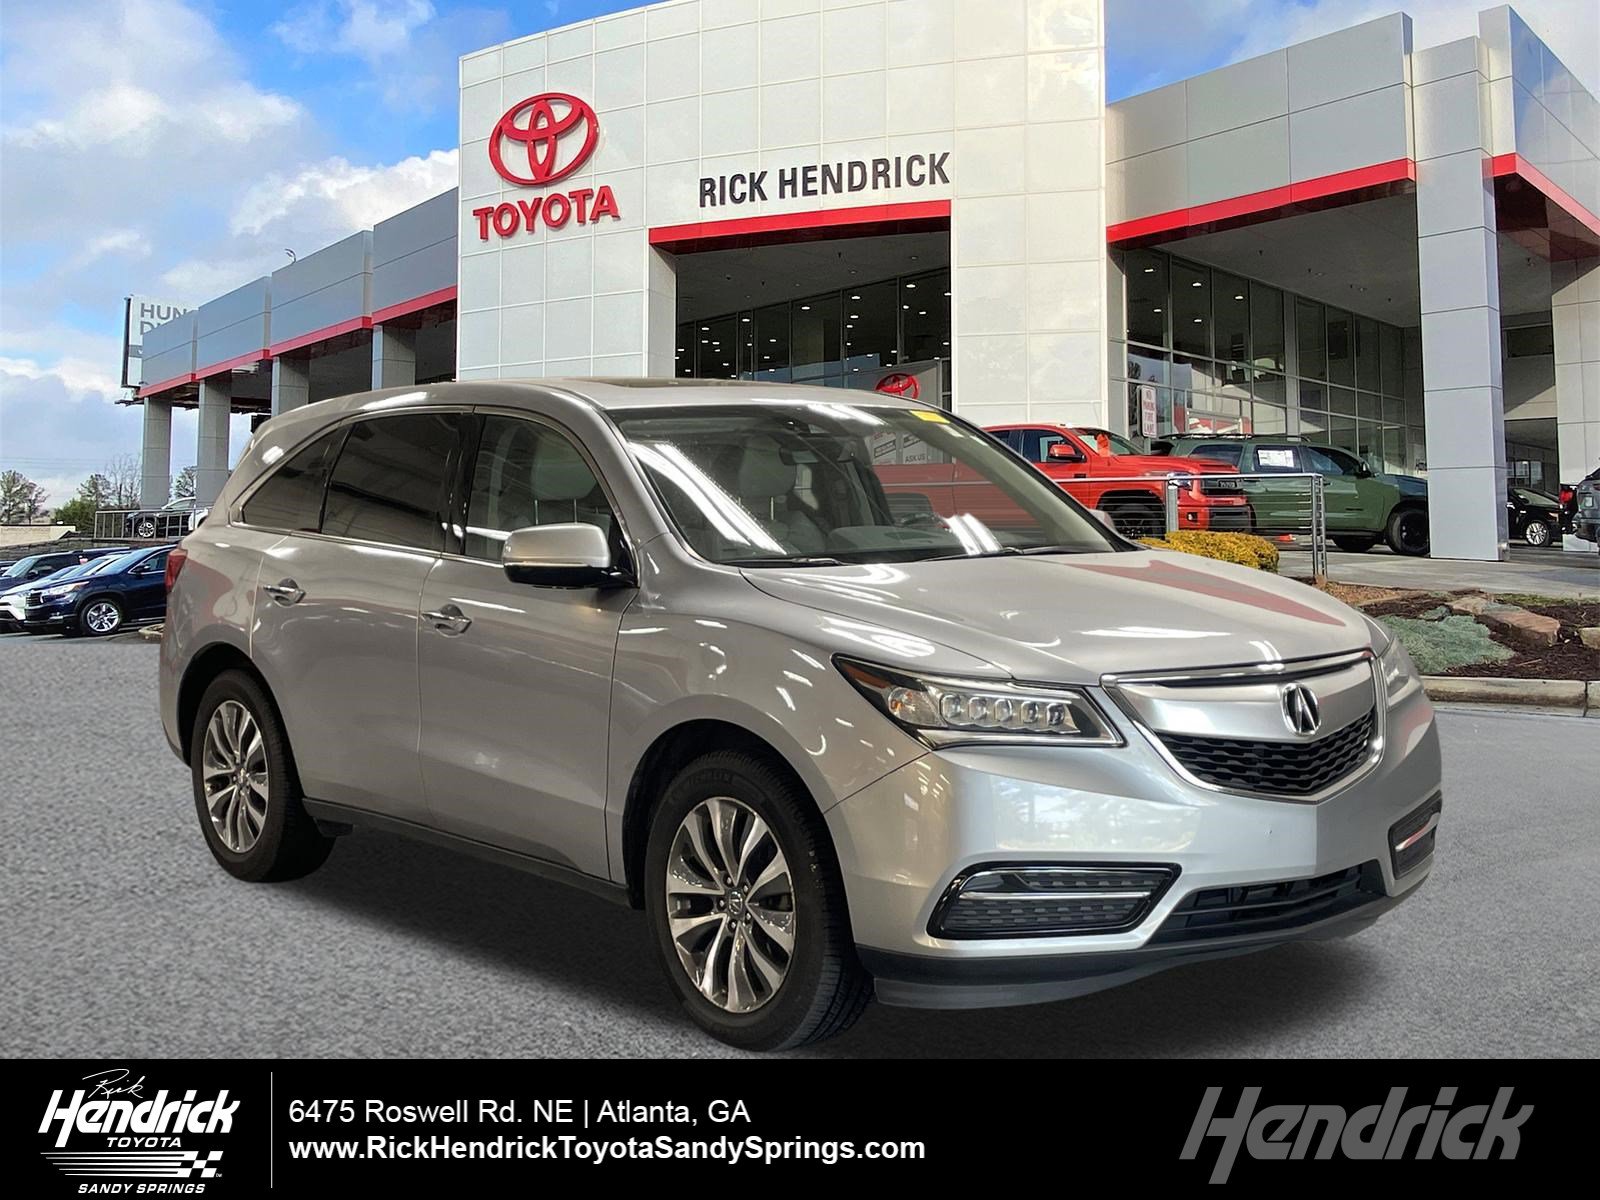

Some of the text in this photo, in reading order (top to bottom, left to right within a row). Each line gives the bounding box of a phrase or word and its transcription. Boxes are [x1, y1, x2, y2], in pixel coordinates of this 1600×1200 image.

[699, 151, 951, 208] RICK HENDRICK
[472, 184, 620, 241] TOYOTA
